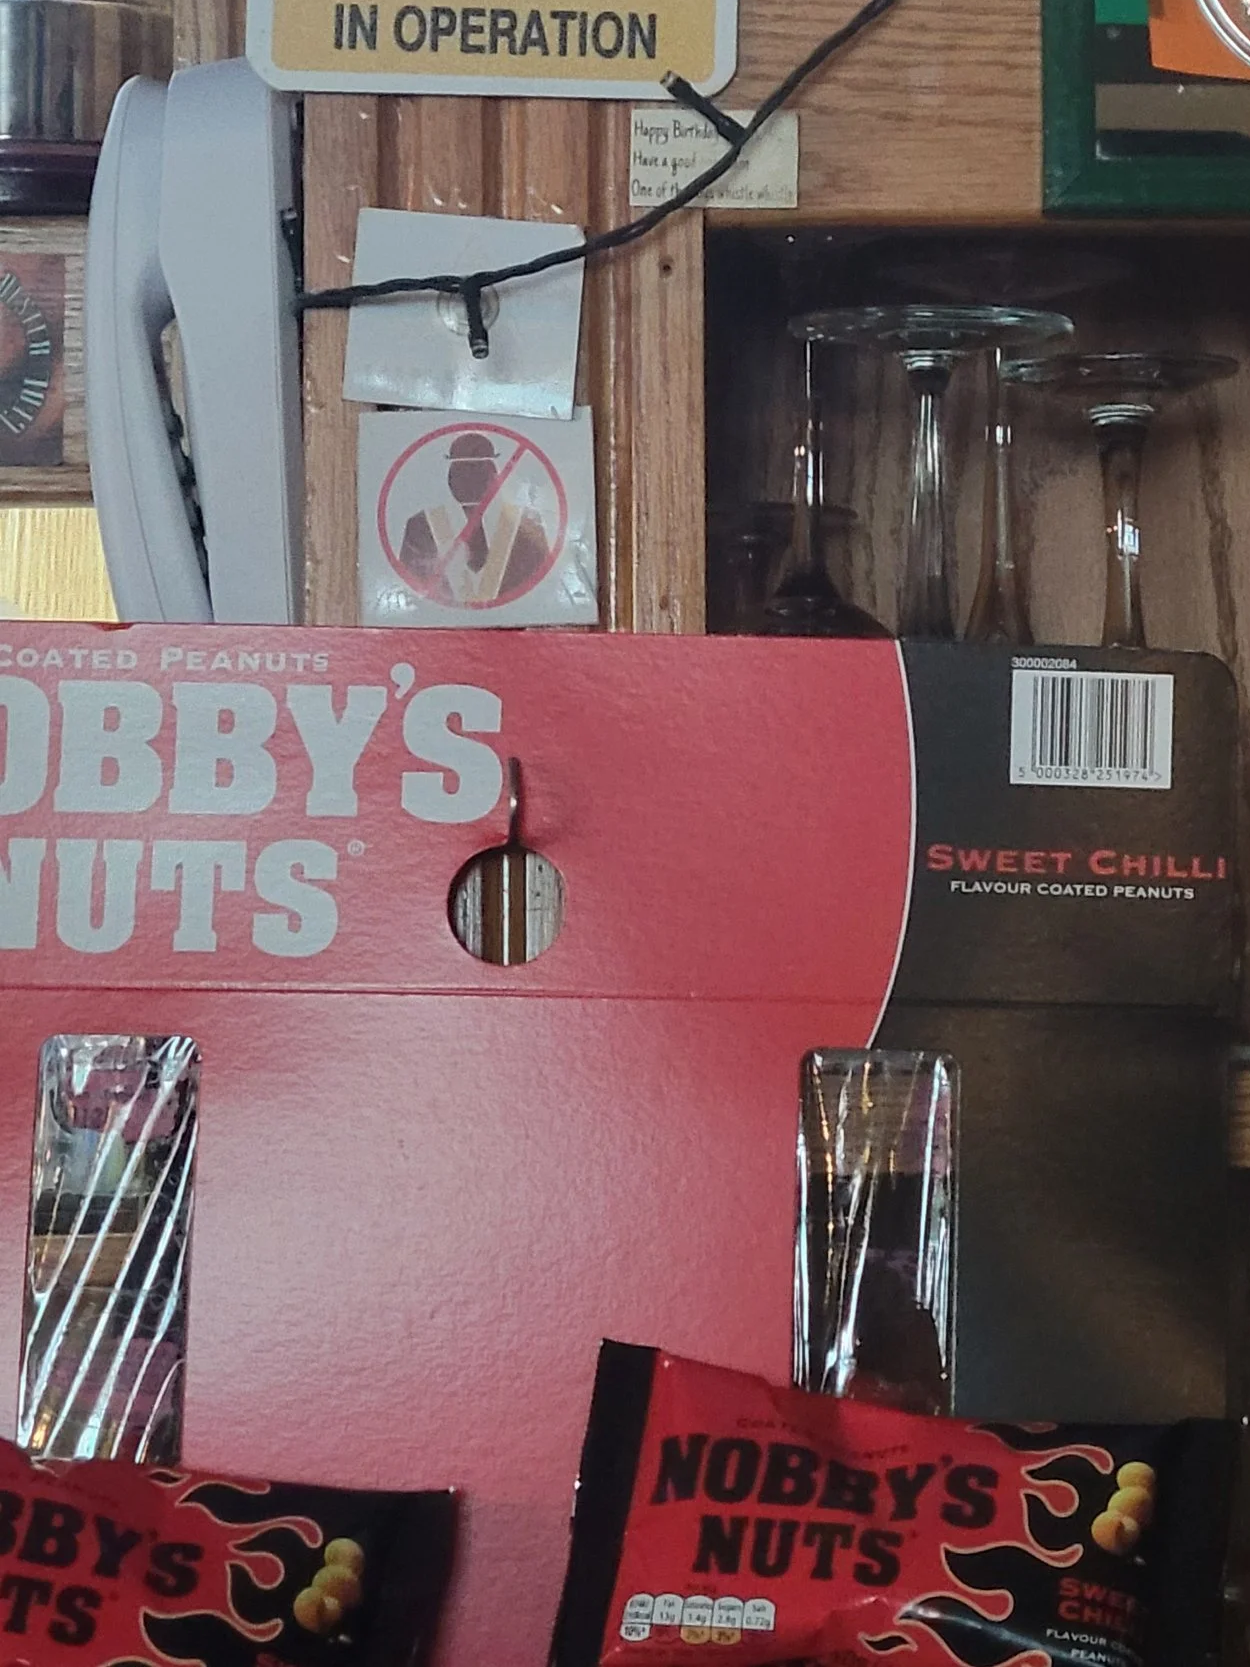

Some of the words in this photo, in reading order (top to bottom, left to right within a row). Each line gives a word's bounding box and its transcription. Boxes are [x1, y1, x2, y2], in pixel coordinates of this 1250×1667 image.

[333, 3, 379, 51] IN
[393, 5, 658, 60] OPERATION
[634, 119, 669, 145] Happy
[633, 151, 659, 167] Have
[661, 157, 668, 167] a
[631, 179, 653, 198] One
[655, 180, 669, 198] of
[1011, 657, 1078, 671] 300002084
[1018, 766, 1026, 778] 5
[1035, 766, 1090, 781] 000328
[1096, 768, 1150, 782] 251974
[927, 843, 1073, 875] SWEET
[1087, 849, 1228, 881] CHILLI
[950, 879, 1032, 896] FLAVOUR
[1036, 881, 1109, 898] COATED
[1112, 884, 1196, 901] PEANUTS
[651, 1432, 1000, 1529] NOBBY'S
[692, 1514, 904, 1587] NUTS
[1046, 1628, 1108, 1647] FLAVOUR
